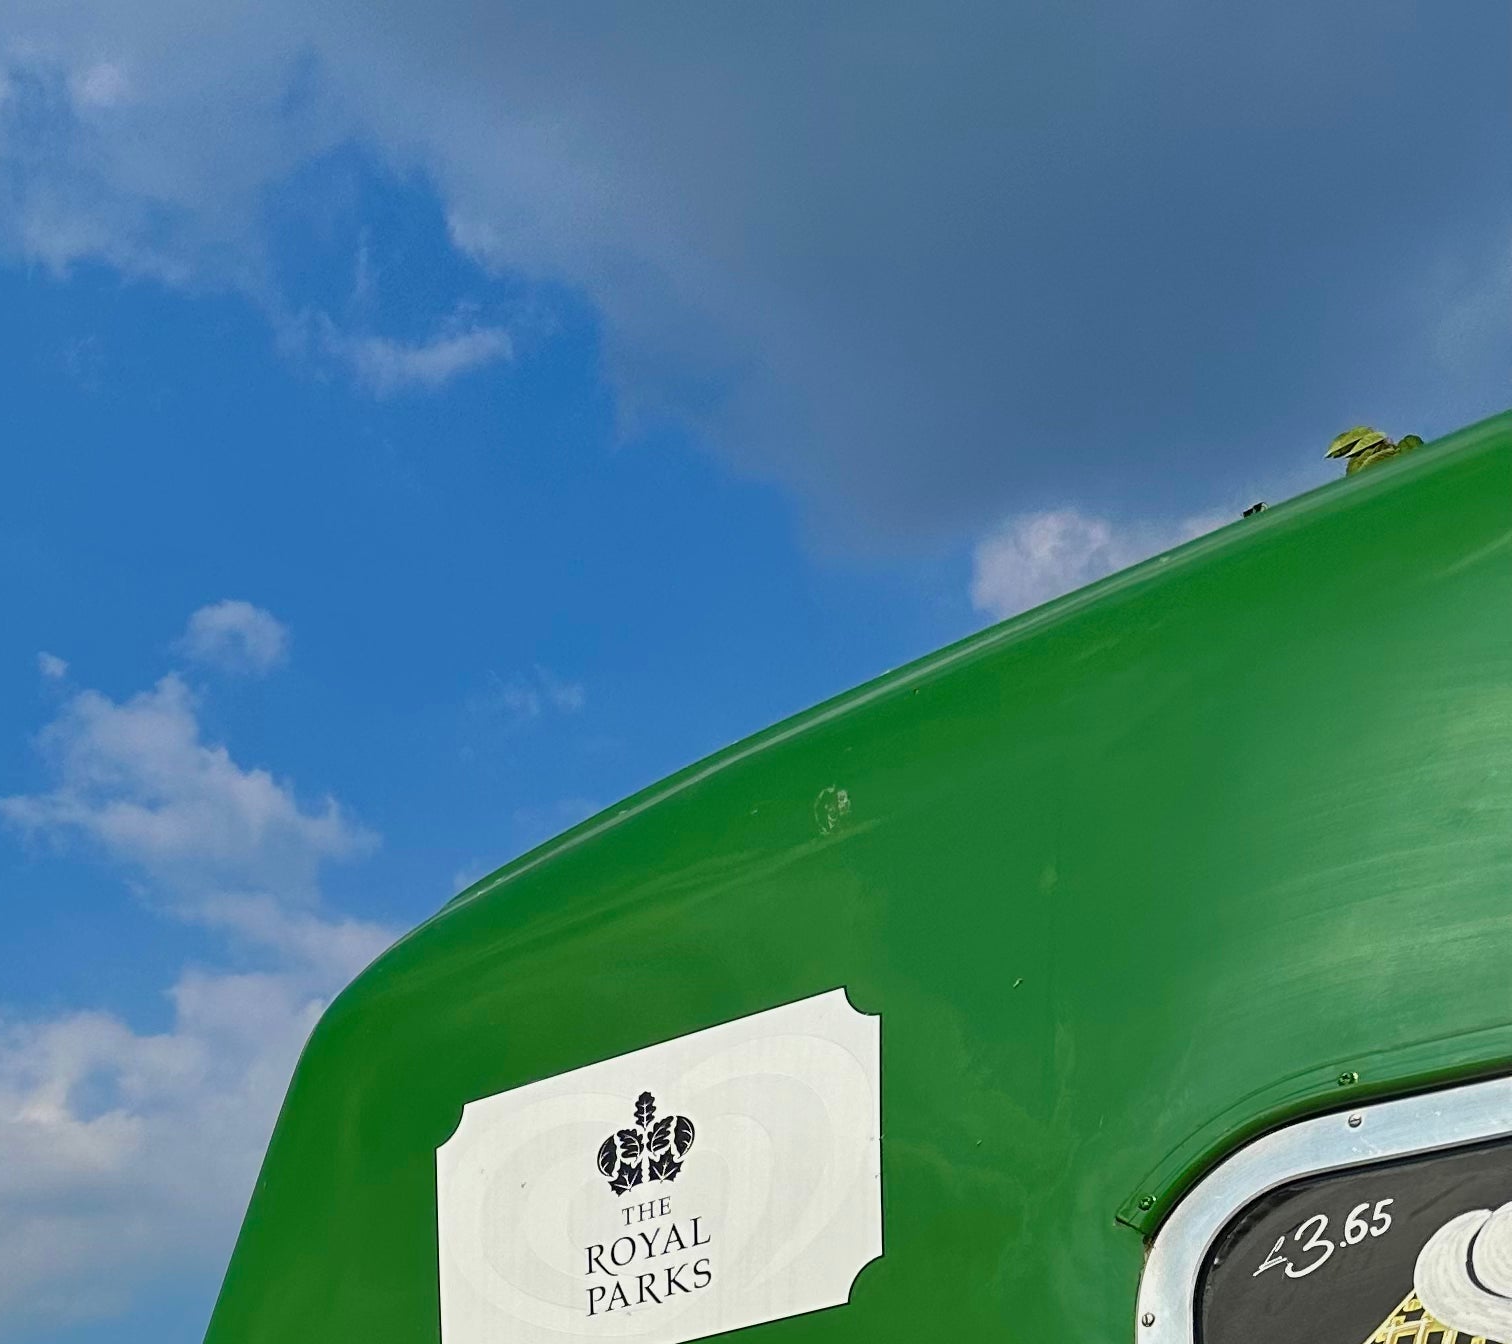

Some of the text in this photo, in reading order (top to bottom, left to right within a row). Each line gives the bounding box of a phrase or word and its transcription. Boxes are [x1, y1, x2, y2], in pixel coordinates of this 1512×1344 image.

[621, 1195, 672, 1226] THE
[1252, 1198, 1394, 1278] £3.65
[584, 1215, 712, 1277] ROYAL
[585, 1258, 712, 1317] PARKS
